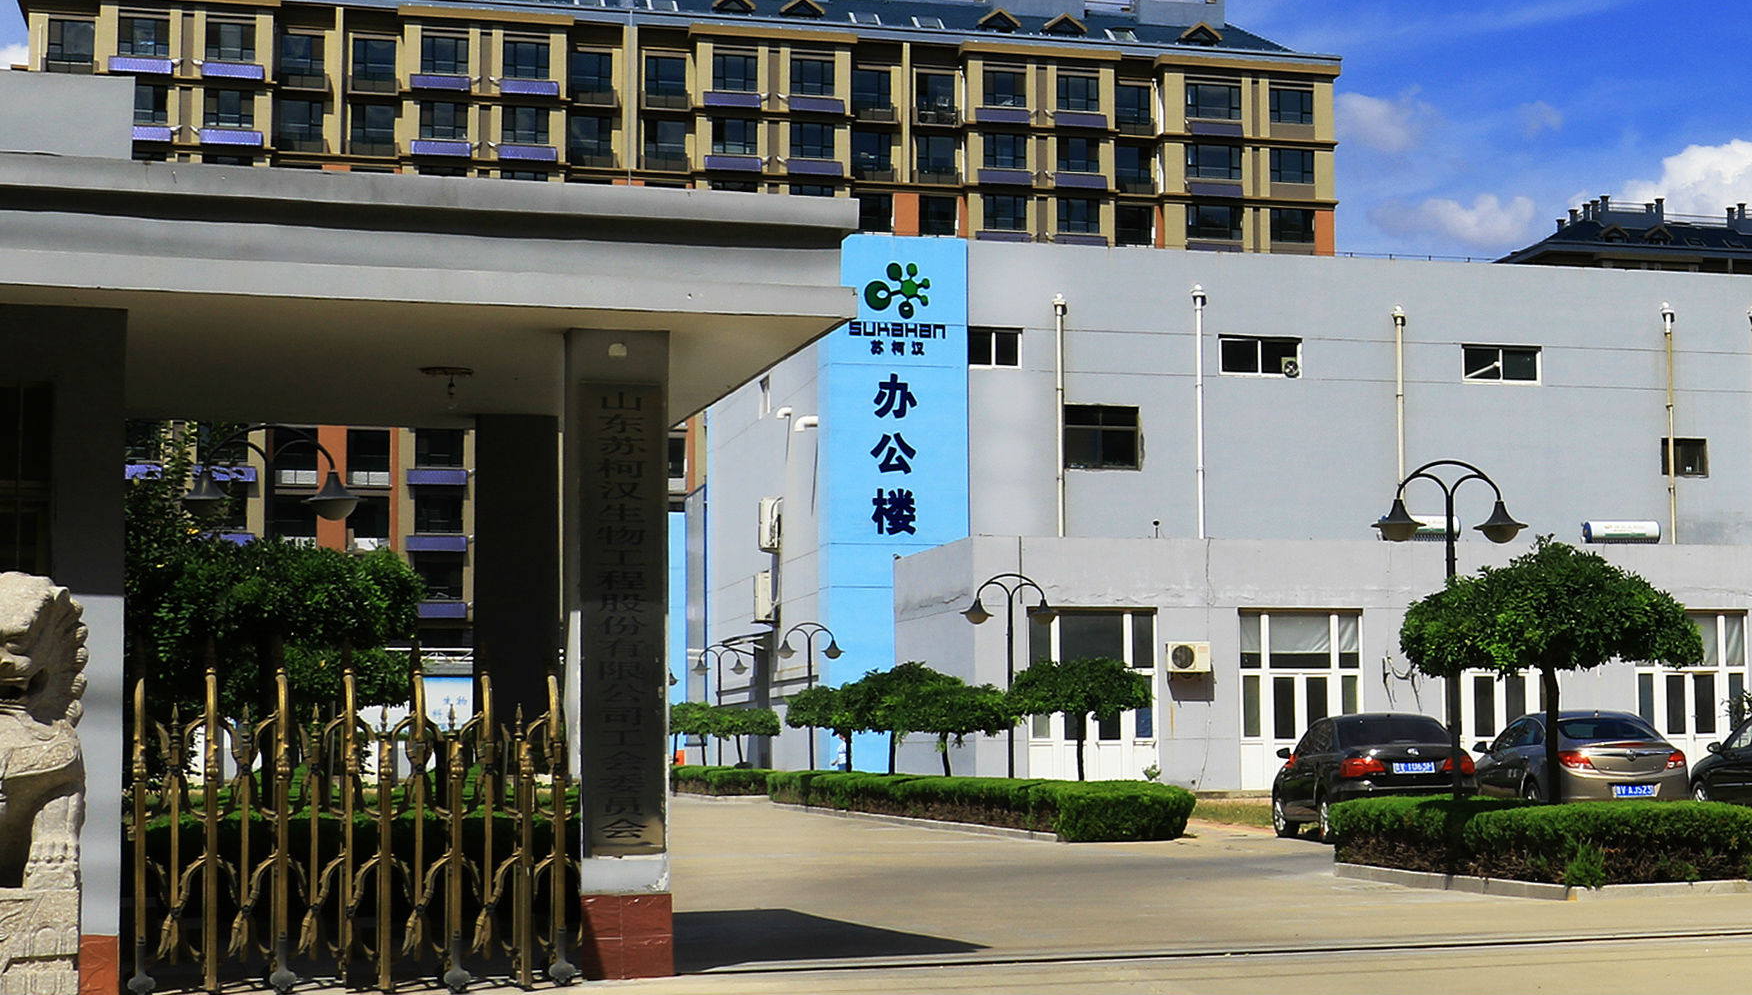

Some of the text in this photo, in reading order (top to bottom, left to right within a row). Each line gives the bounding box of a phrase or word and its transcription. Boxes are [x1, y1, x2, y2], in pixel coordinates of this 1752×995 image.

[870, 340, 925, 356] 苏柯汉
[870, 373, 917, 535] 办公楼
[592, 391, 649, 839] 山东苏柯汉生物工程股份有限公司工会委员会
